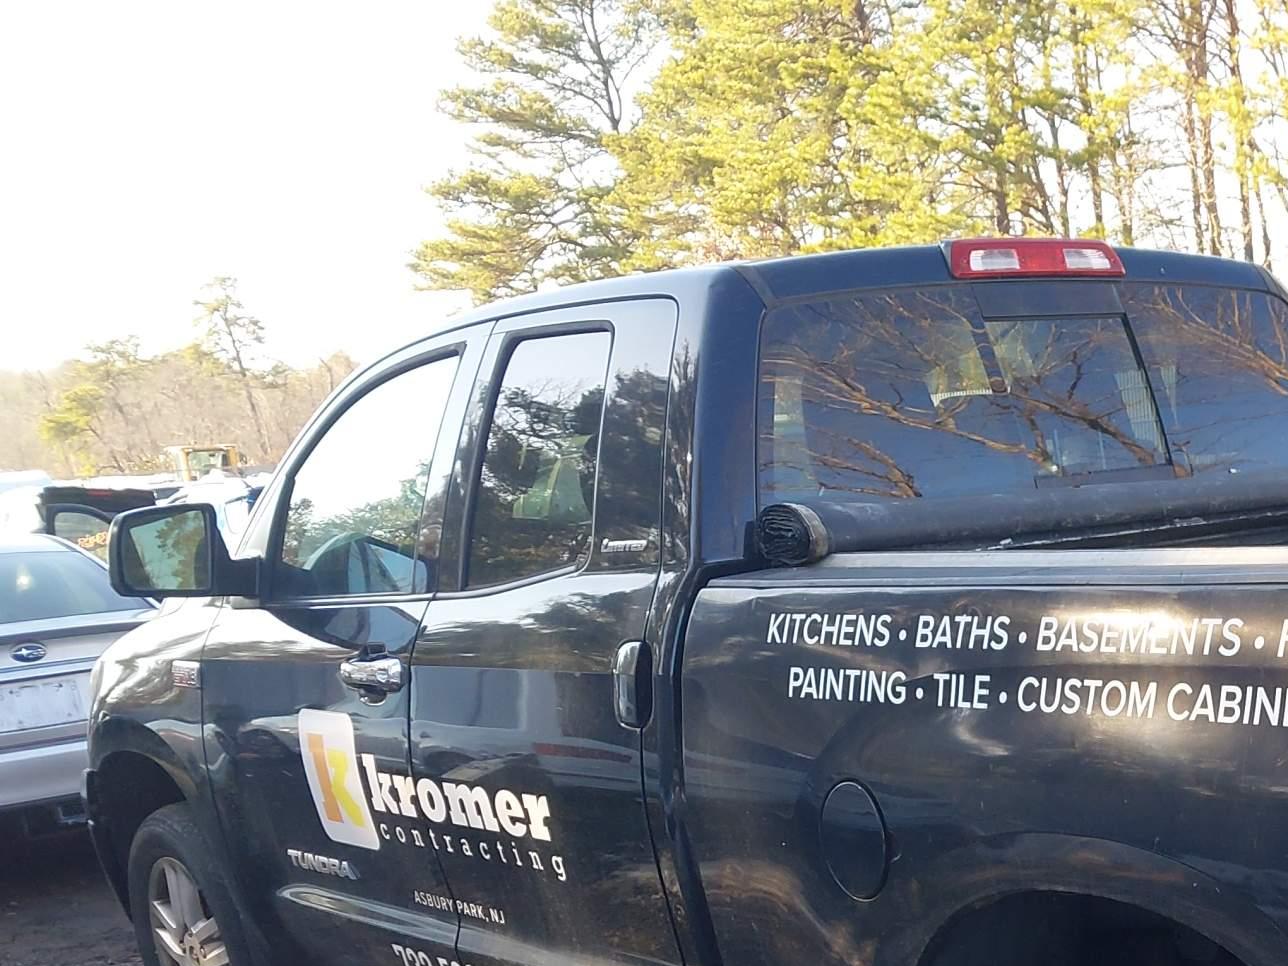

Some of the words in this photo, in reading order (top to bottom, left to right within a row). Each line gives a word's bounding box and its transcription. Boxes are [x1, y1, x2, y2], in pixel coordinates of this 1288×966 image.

[766, 612, 890, 648] KITCHENS
[914, 615, 1011, 650] BATHS
[1035, 617, 1242, 657] BASEMENTS
[788, 668, 905, 704] PAINTING
[933, 673, 990, 709] TILE
[1017, 677, 1157, 719] CUSTOM
[361, 753, 551, 841] kromer
[287, 848, 360, 880] TUNDRA
[380, 822, 567, 881] contracting
[414, 889, 453, 913] ASBURY
[456, 900, 489, 923] PARK,
[489, 907, 505, 925] NJ
